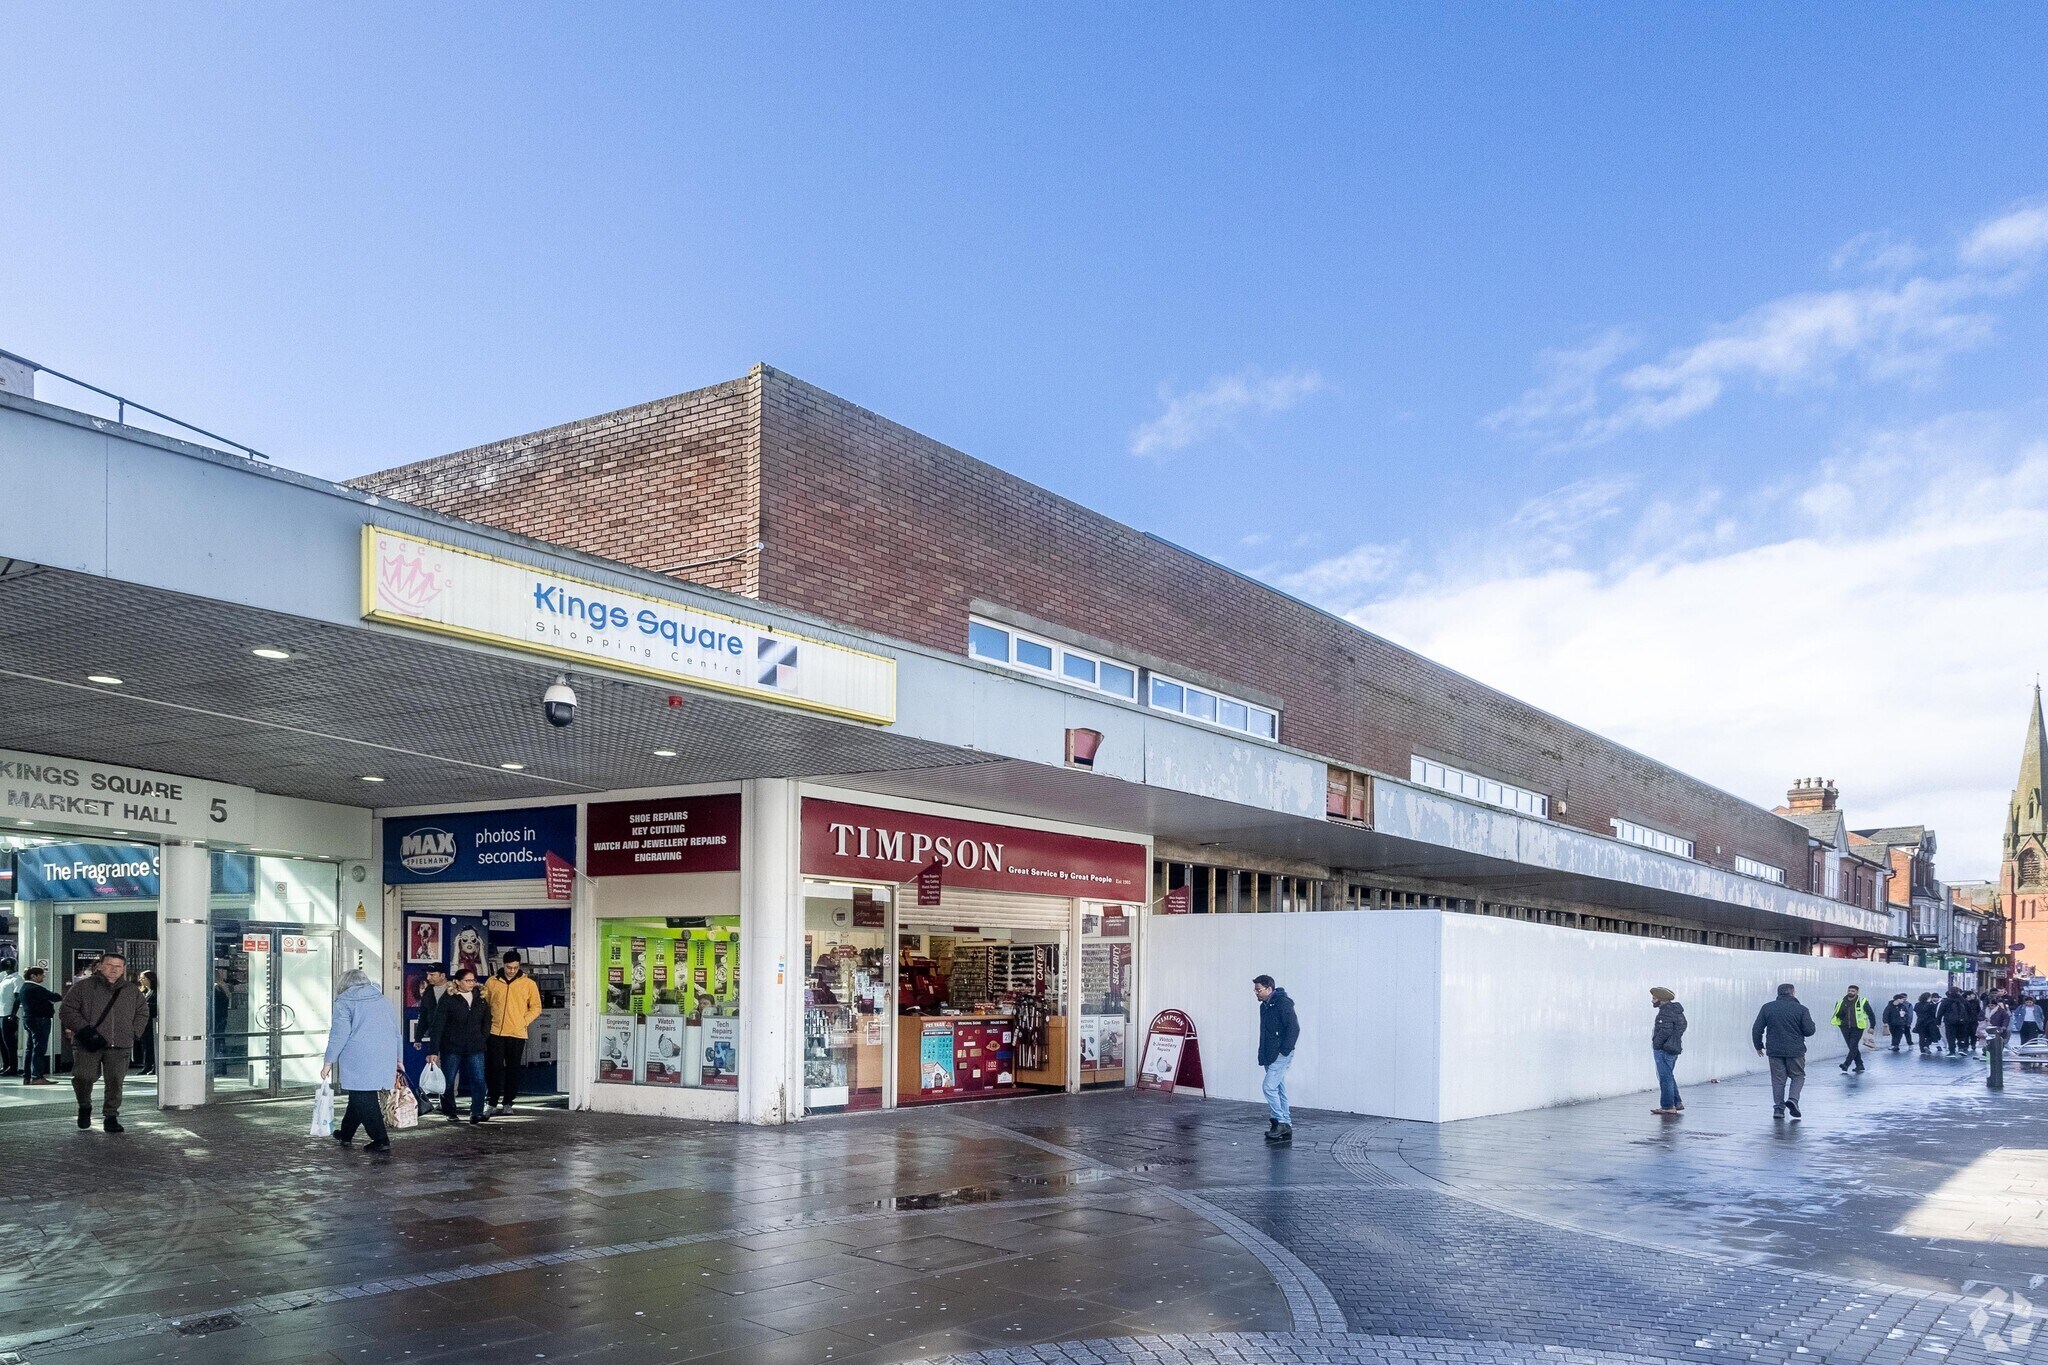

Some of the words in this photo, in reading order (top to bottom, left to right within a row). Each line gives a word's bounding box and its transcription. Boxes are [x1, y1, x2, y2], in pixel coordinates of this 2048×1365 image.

[534, 582, 629, 630] Kings
[637, 609, 743, 655] Square
[536, 621, 651, 658] Shopping
[671, 652, 741, 676] Centre
[0, 760, 79, 787] KINGS
[91, 773, 183, 800] SQUARE
[8, 789, 114, 817] MARKET
[124, 803, 177, 825] HALL
[209, 798, 228, 823] 5
[629, 813, 651, 823] SHOE
[652, 811, 688, 822] REPAIRS
[475, 828, 521, 847] photos
[524, 827, 536, 841] in
[632, 827, 648, 836] KEY
[650, 824, 685, 835] CUTTING
[402, 832, 454, 856] MAX
[594, 841, 620, 851] WATCH
[622, 840, 639, 850] AND
[641, 838, 688, 849] JEWELLERY
[690, 835, 727, 846] REPAIRS
[829, 823, 1004, 872] TIMPSON
[406, 857, 449, 866] SPIELMANN
[478, 848, 546, 865] seconds...
[634, 851, 682, 862] ENGRAVING
[44, 863, 71, 881] The
[73, 861, 150, 885] Fragrance
[1008, 866, 1029, 875] Great
[1031, 868, 1058, 878] Service
[1059, 871, 1069, 880] By
[1070, 872, 1089, 881] Great
[1090, 874, 1112, 884] People
[489, 920, 510, 928] OTOS
[1112, 944, 1121, 985] SECURITY
[655, 1024, 676, 1032] Repairs
[1157, 1014, 1184, 1027] TIMPSON
